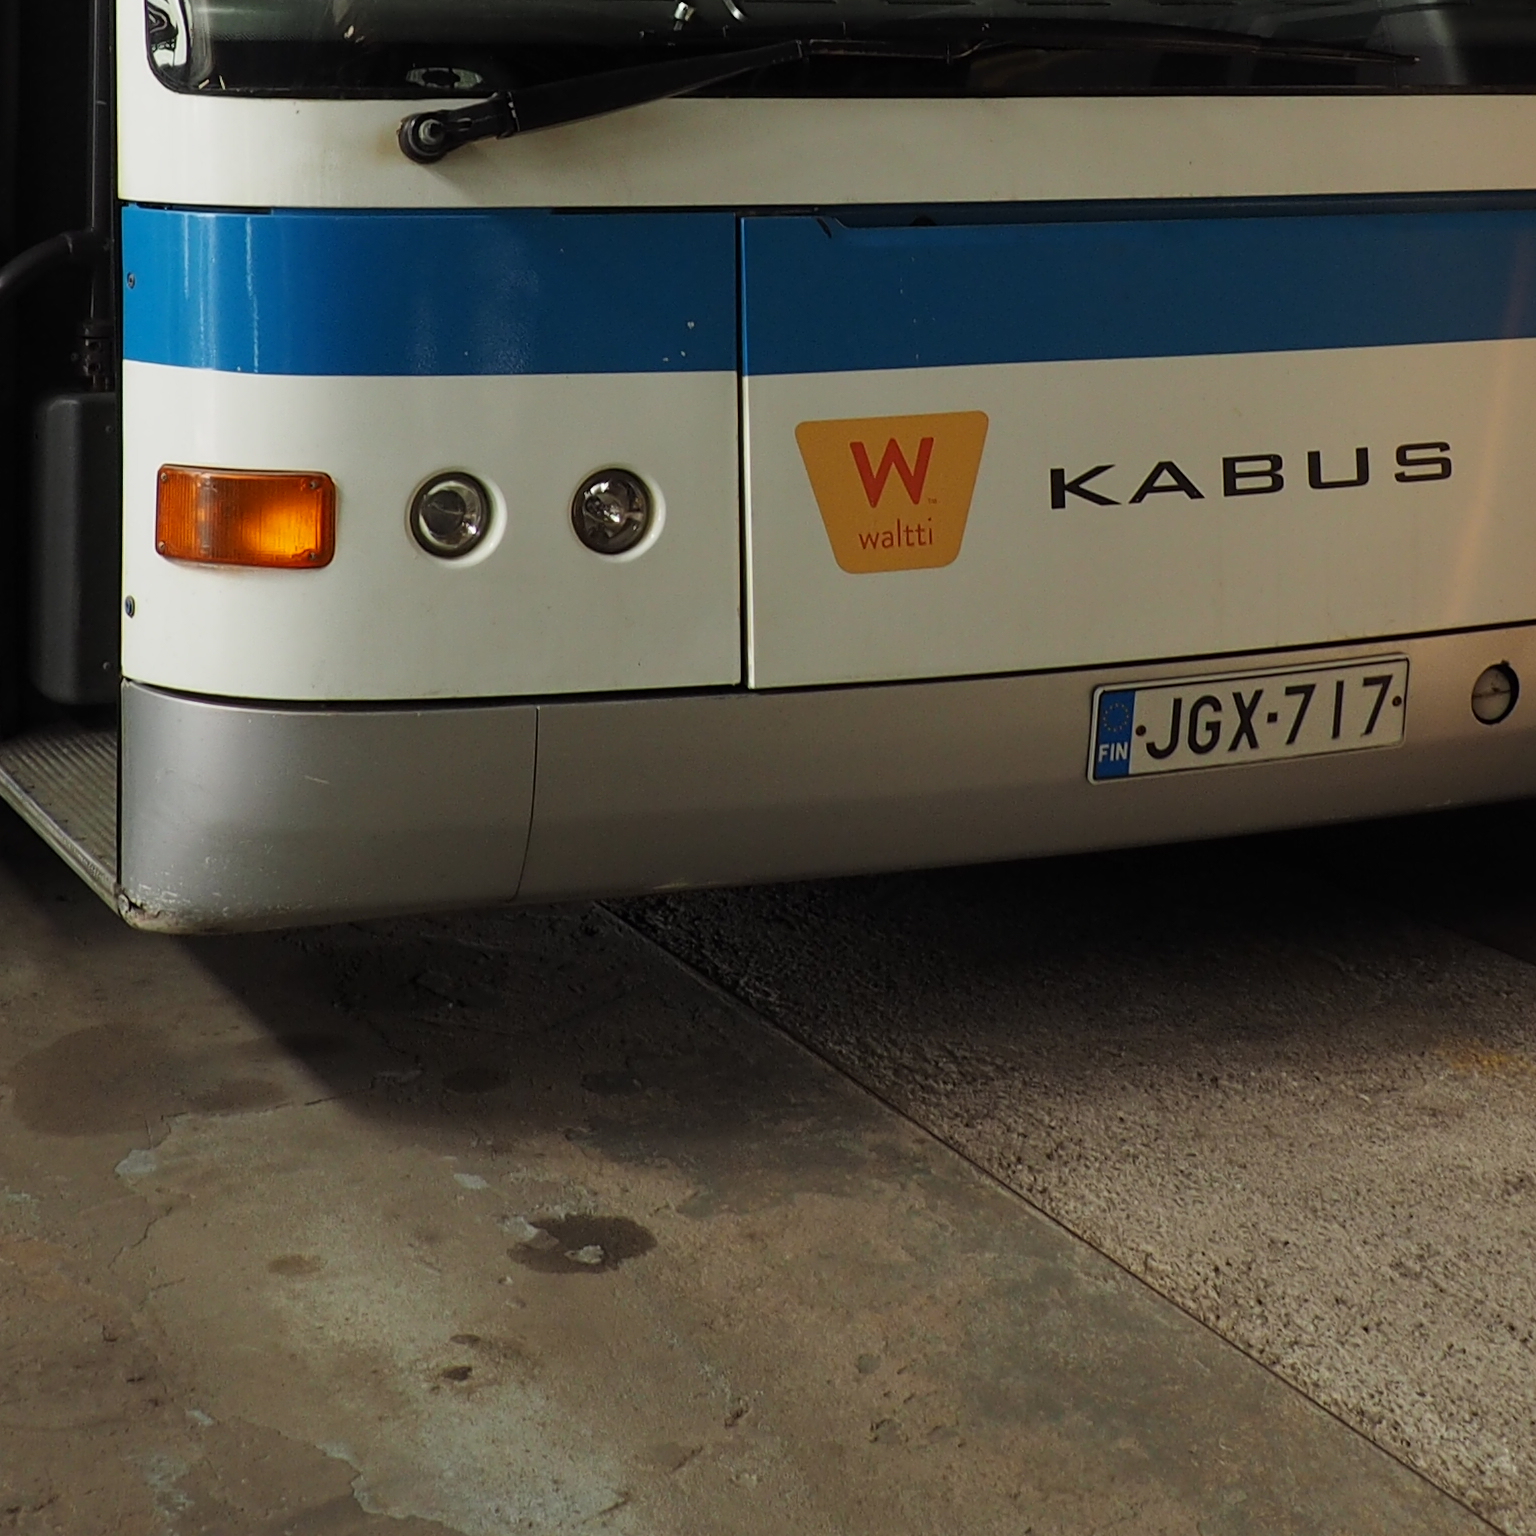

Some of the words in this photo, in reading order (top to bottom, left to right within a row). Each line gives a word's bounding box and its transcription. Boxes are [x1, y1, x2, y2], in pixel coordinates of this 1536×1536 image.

[850, 437, 934, 508] W
[1050, 441, 1452, 509] KABUS
[859, 517, 933, 549] waltti
[1146, 675, 1393, 759] JGX-717
[1098, 742, 1128, 762] FIN
